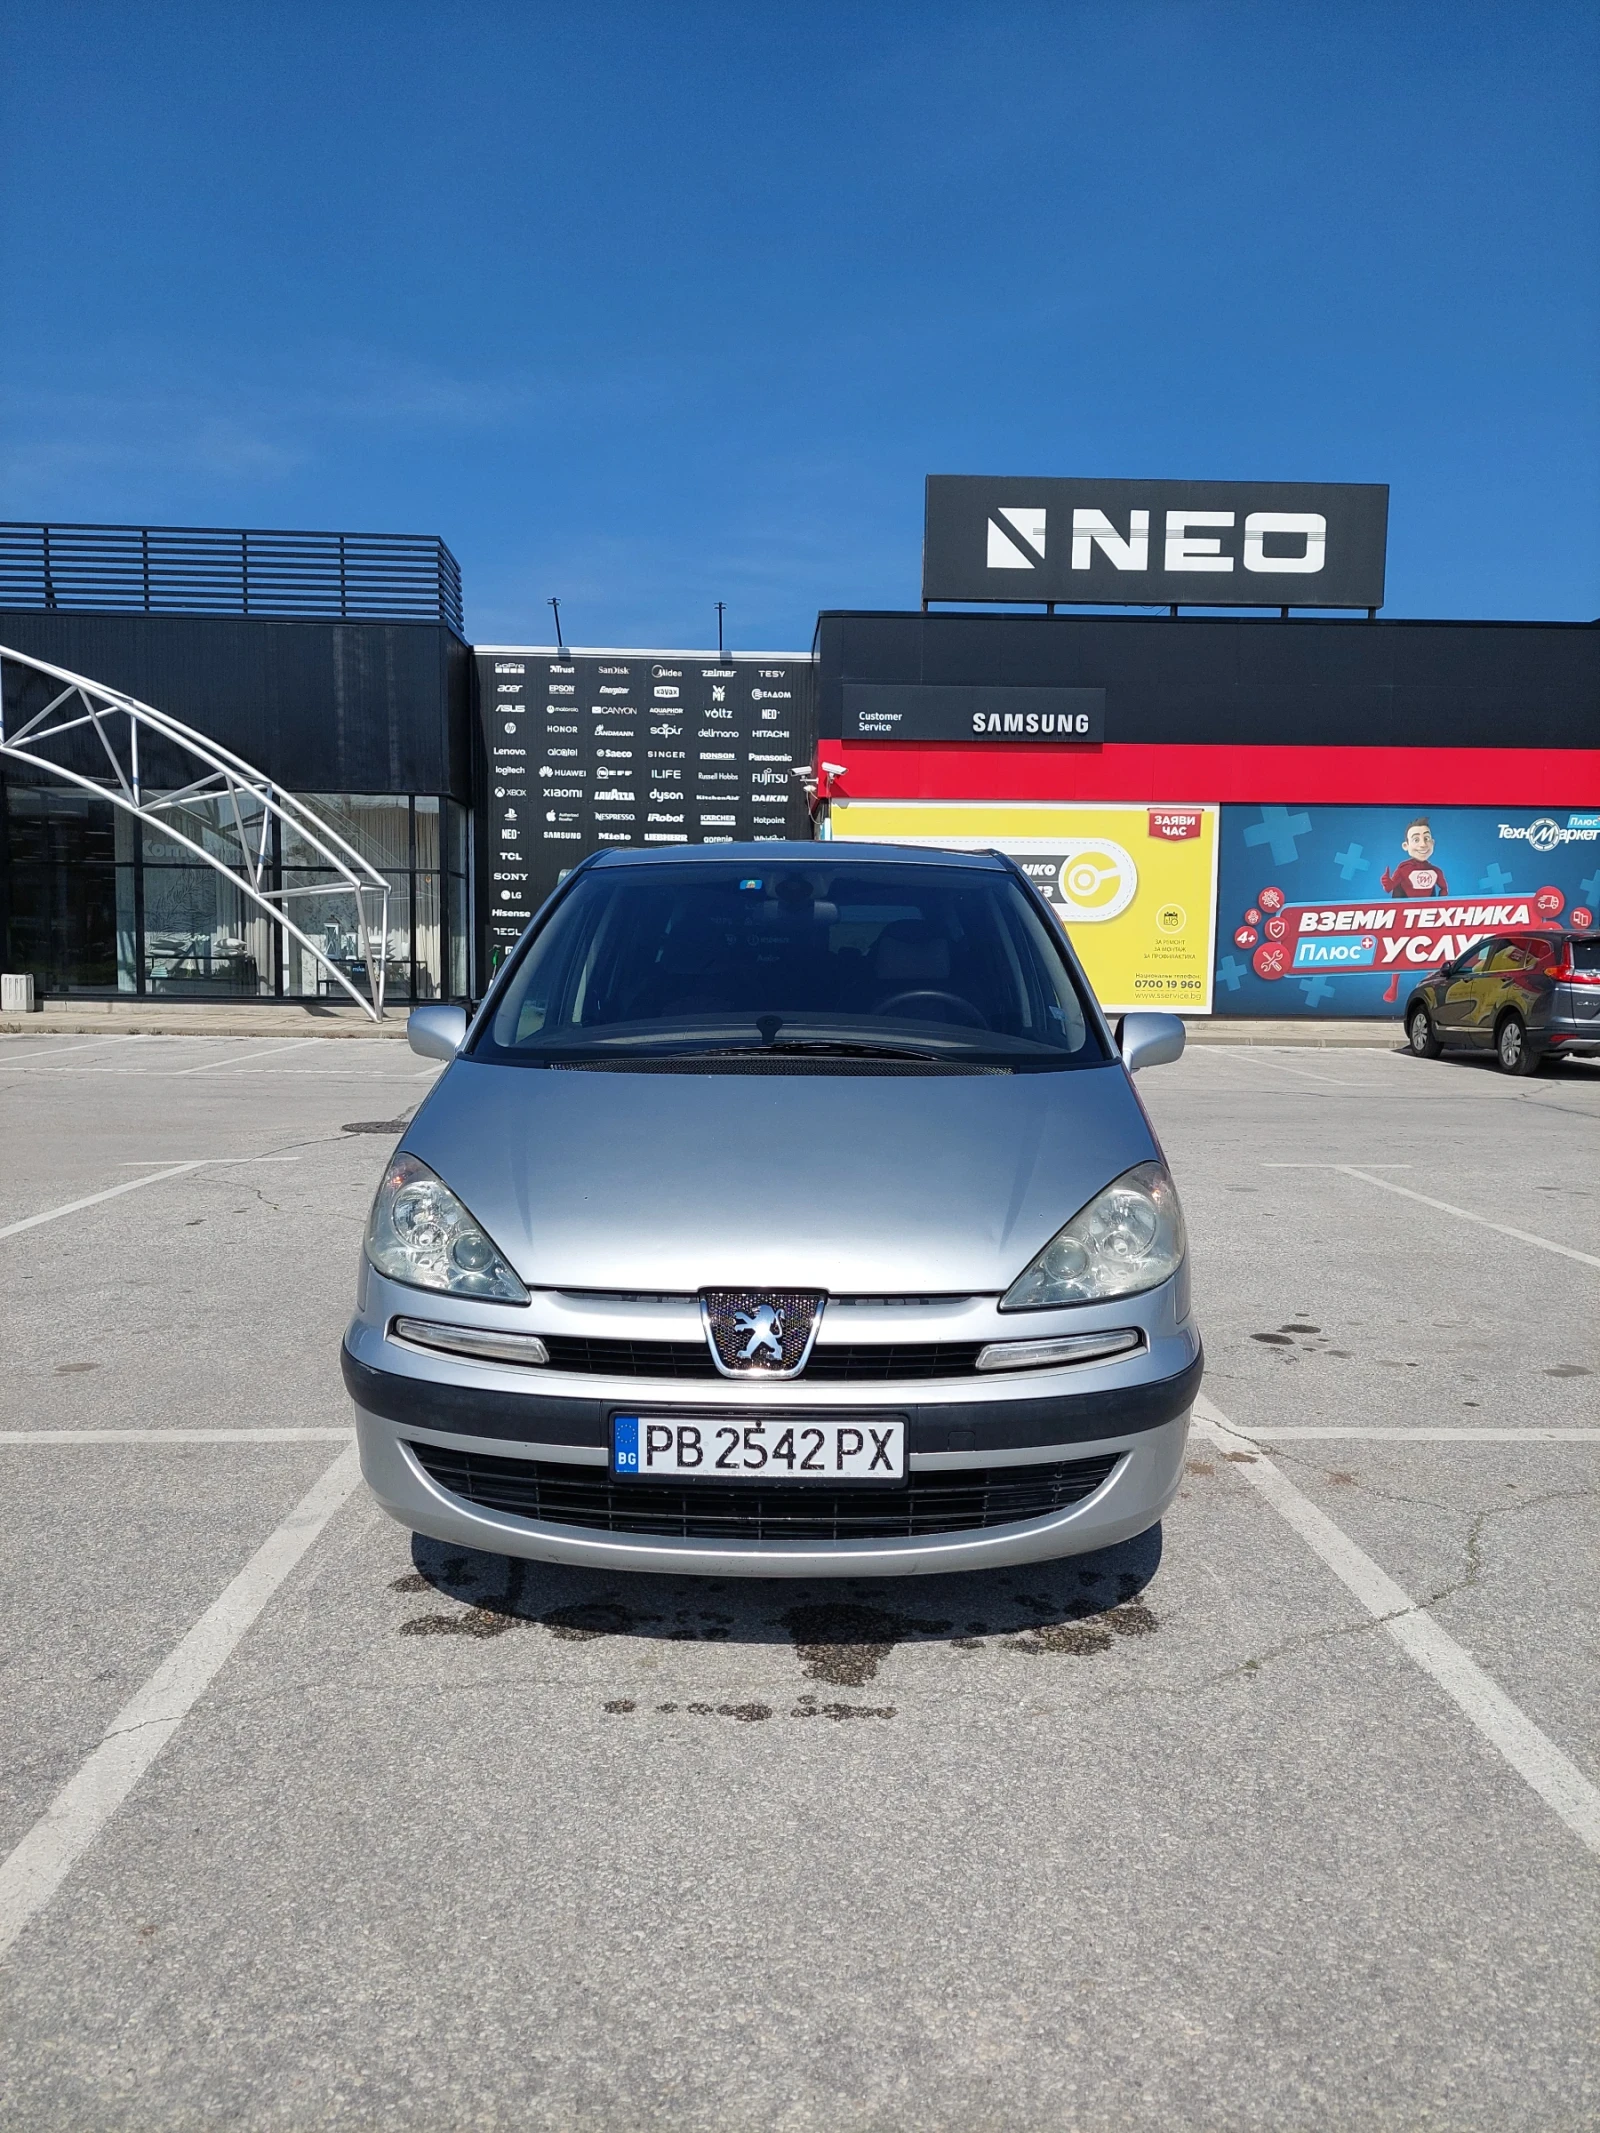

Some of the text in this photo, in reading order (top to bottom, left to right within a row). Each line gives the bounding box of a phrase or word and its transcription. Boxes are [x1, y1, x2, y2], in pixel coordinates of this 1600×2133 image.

[1071, 508, 1327, 574] NEO
[555, 665, 576, 674] Trust
[598, 666, 630, 675] SanDisk
[701, 668, 738, 678] zelmer
[758, 670, 786, 678] TESY
[497, 685, 524, 693] acer
[549, 684, 576, 692] EPSON
[599, 685, 630, 696] Energizer
[712, 684, 726, 702] WMF
[495, 704, 526, 713] ASUS
[601, 706, 638, 715] CANYON
[761, 709, 777, 720] NEO
[858, 711, 903, 722] Customer
[505, 722, 517, 734] hp
[858, 721, 892, 732] Service
[972, 712, 1090, 735] SAMSUNG
[547, 725, 578, 734] HONOR
[594, 727, 635, 737] LANDMANN
[649, 723, 684, 739] sapir
[698, 728, 740, 738] delimano
[752, 729, 790, 738] HITACHI
[493, 747, 527, 756] Lenovo
[547, 748, 578, 758] alcatel
[604, 749, 633, 758] Saeco
[647, 750, 686, 759] SINGER
[700, 752, 736, 760] RONSON
[748, 752, 793, 762] Panasonic
[495, 765, 526, 776] logitech
[554, 769, 587, 778] HUAWEI
[651, 769, 682, 780] ILIFE
[698, 772, 739, 782] Russell Hobbs
[751, 768, 788, 786] FUJITSU
[506, 788, 527, 797] XBOX
[594, 789, 636, 802] LAVAZZA
[649, 788, 684, 803] dyson
[696, 794, 741, 802] KitchenAid
[751, 794, 789, 803] DAIKIN
[594, 811, 636, 822] NESPRESSO
[647, 813, 685, 823] iRobot
[753, 816, 786, 826] Hotpoint
[1154, 815, 1196, 826] ЗАЯВИ
[1569, 817, 1599, 827] Плюс
[501, 829, 518, 840] NEO
[543, 831, 582, 840] SAMSUNG
[1162, 825, 1188, 836] ЧАС
[598, 832, 632, 841] Miele
[644, 833, 689, 843] LIEBHERR
[499, 851, 523, 861] TCL
[493, 872, 529, 881] SONY
[511, 891, 522, 900] LG
[491, 908, 531, 918] Hisense
[1298, 904, 1531, 932] ВЗЕМИ ТЕХНИКА
[1236, 930, 1256, 945] 4+
[1298, 943, 1363, 962] Плюс
[1134, 979, 1202, 989] 0700 19 960
[1135, 992, 1202, 1001] www.sservice.bg
[646, 1424, 895, 1472] PB 2542 PX
[617, 1452, 637, 1466] BG
